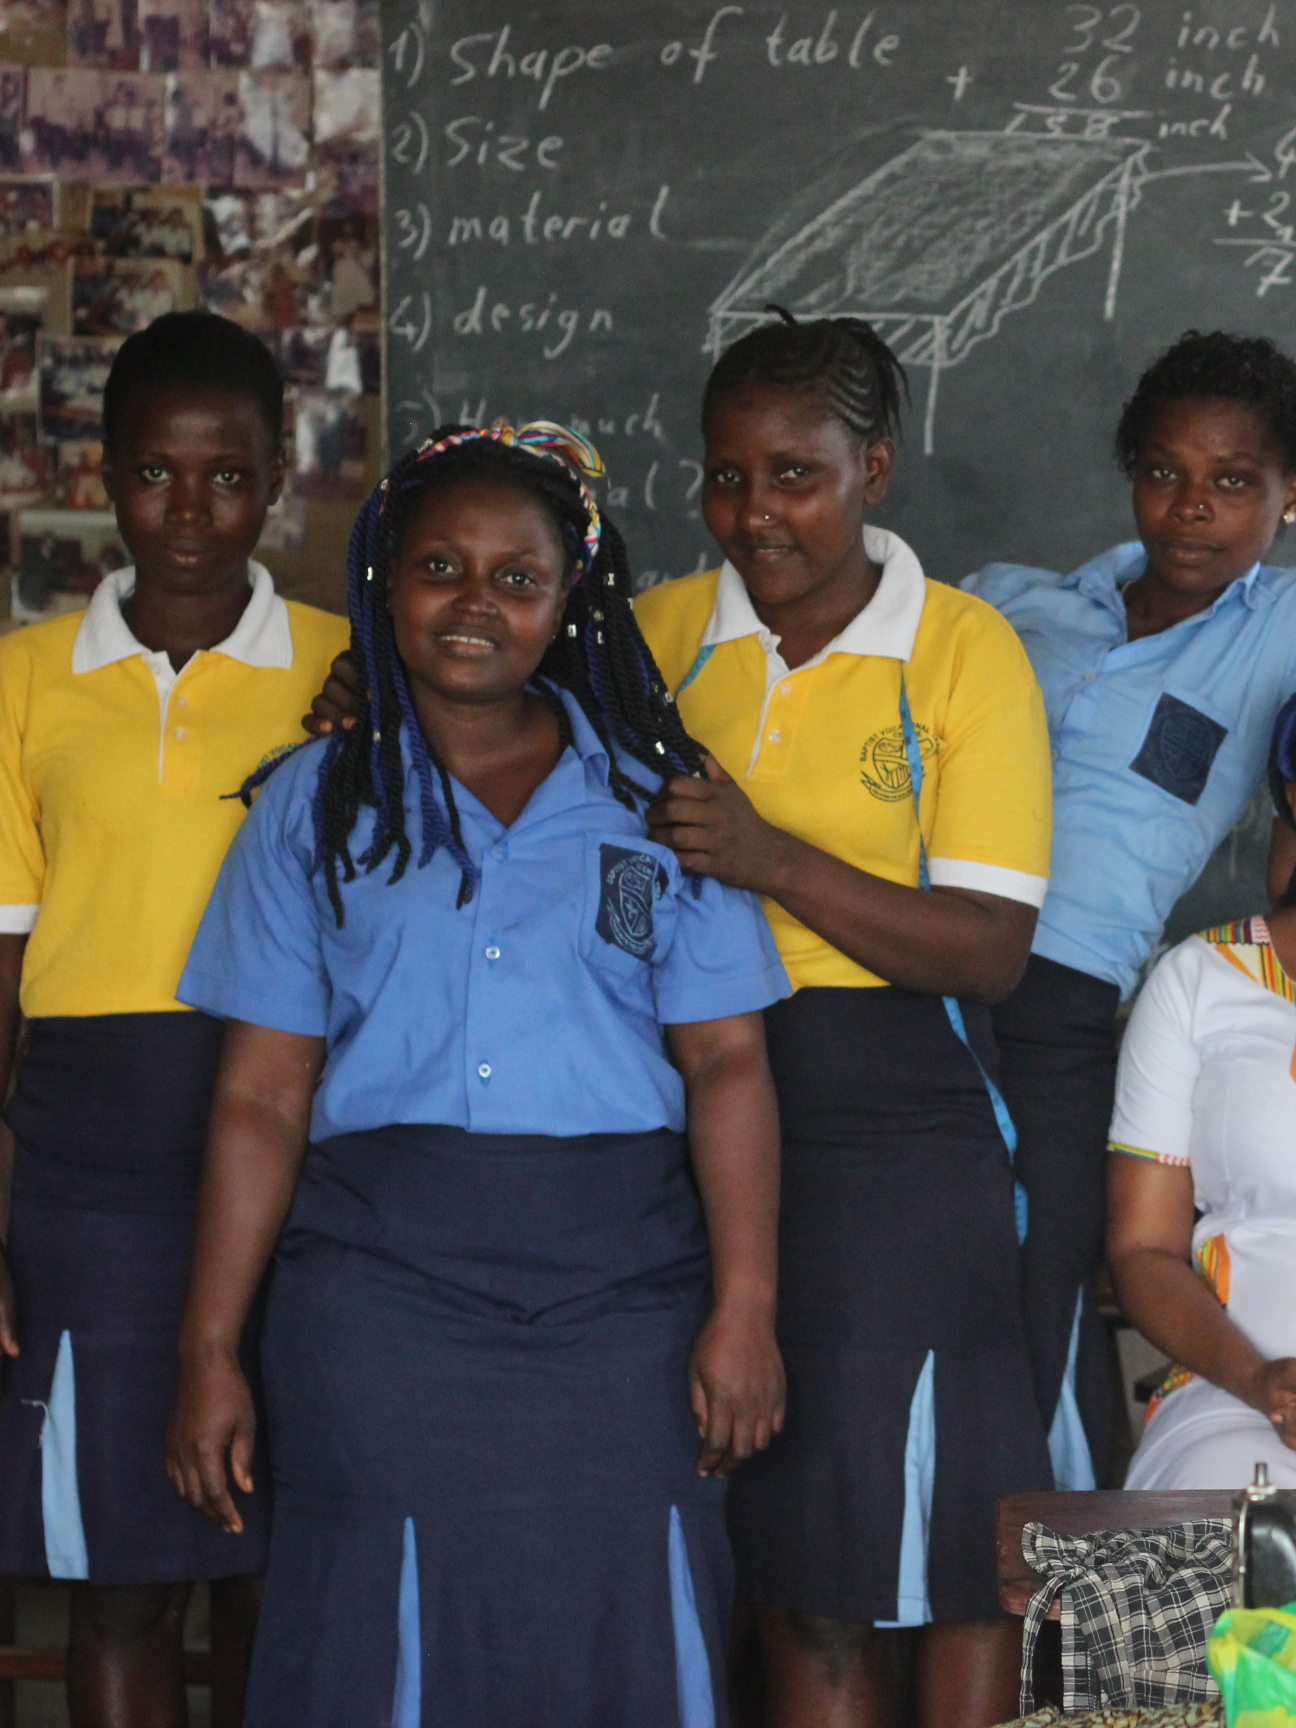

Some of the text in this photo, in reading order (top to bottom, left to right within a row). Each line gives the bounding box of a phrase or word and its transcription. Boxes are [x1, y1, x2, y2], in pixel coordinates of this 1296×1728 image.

[389, 6, 900, 111] 1) Shape of table
[1063, 5, 1281, 53] 32 inch
[1048, 55, 1122, 101] 26
[1166, 54, 1266, 98] inch
[391, 110, 564, 174] 2) Size
[396, 185, 669, 260] 3) material
[453, 285, 613, 359] design
